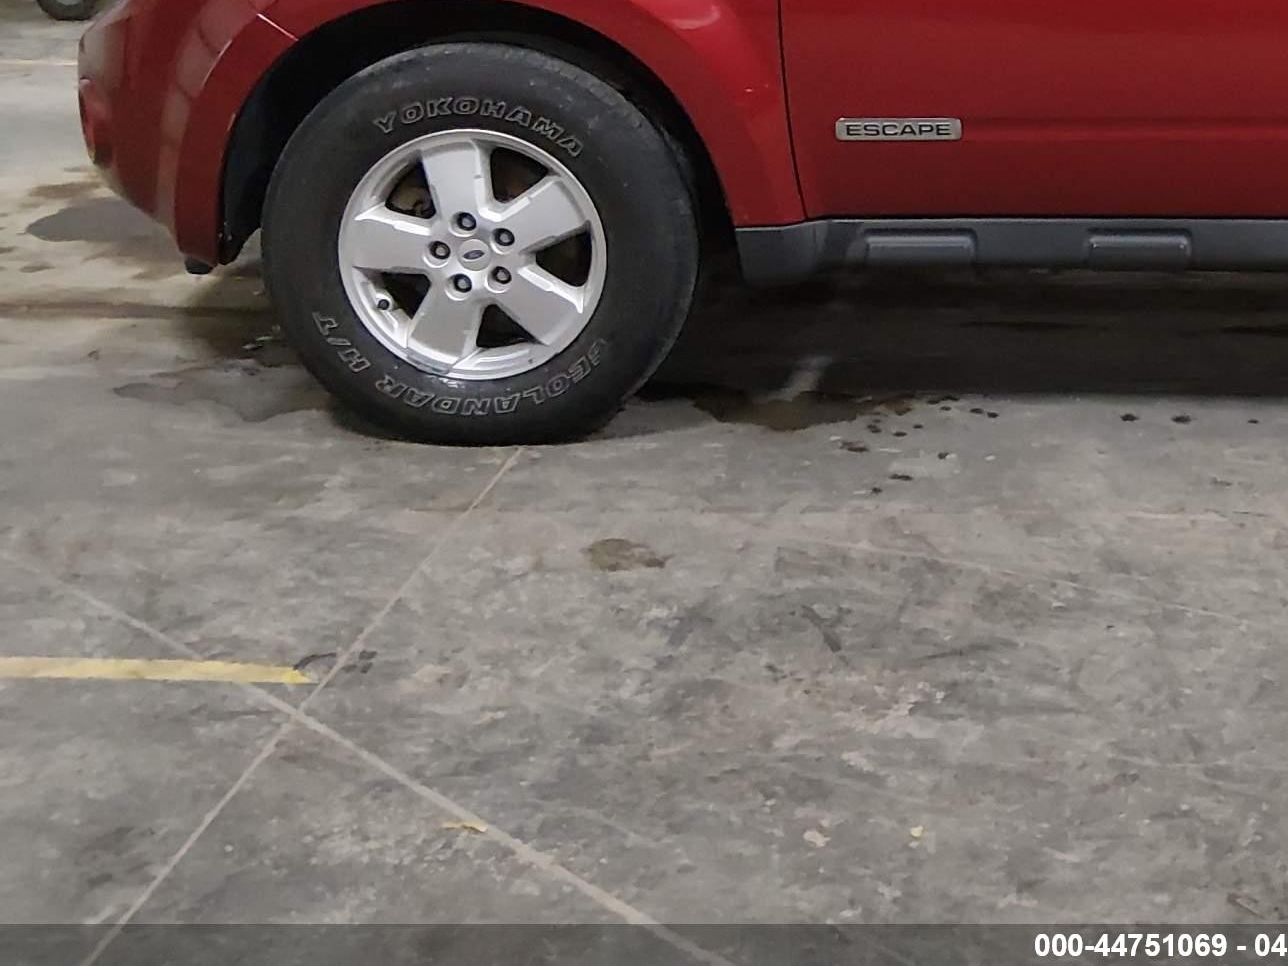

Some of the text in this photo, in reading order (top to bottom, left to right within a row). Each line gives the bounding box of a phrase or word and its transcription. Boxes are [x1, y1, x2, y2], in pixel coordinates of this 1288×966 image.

[374, 97, 584, 157] YOKOHAMA
[846, 124, 951, 136] ESCAPE
[312, 312, 371, 373] H/T
